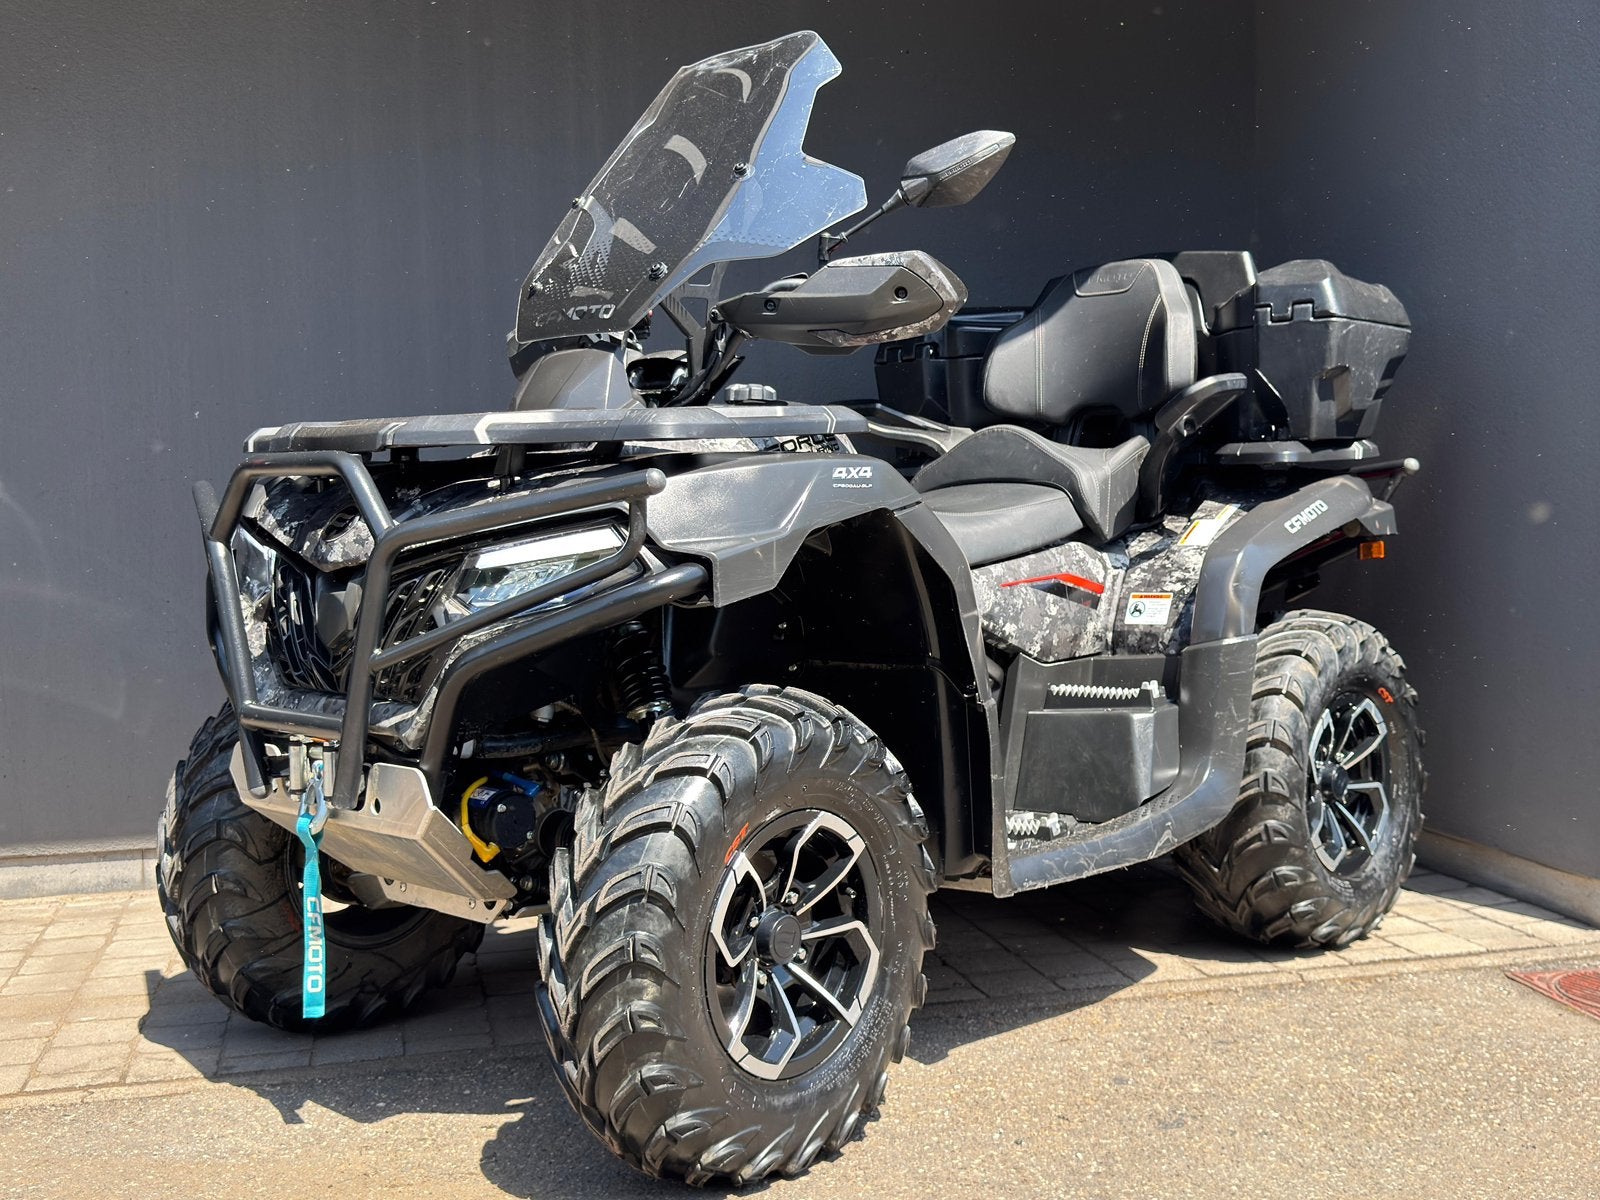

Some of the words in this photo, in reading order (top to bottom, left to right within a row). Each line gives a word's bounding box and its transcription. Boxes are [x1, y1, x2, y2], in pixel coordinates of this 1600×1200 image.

[1283, 499, 1329, 534] CFMOTO
[1377, 687, 1395, 704] CST
[306, 896, 323, 993] CFMOTO
